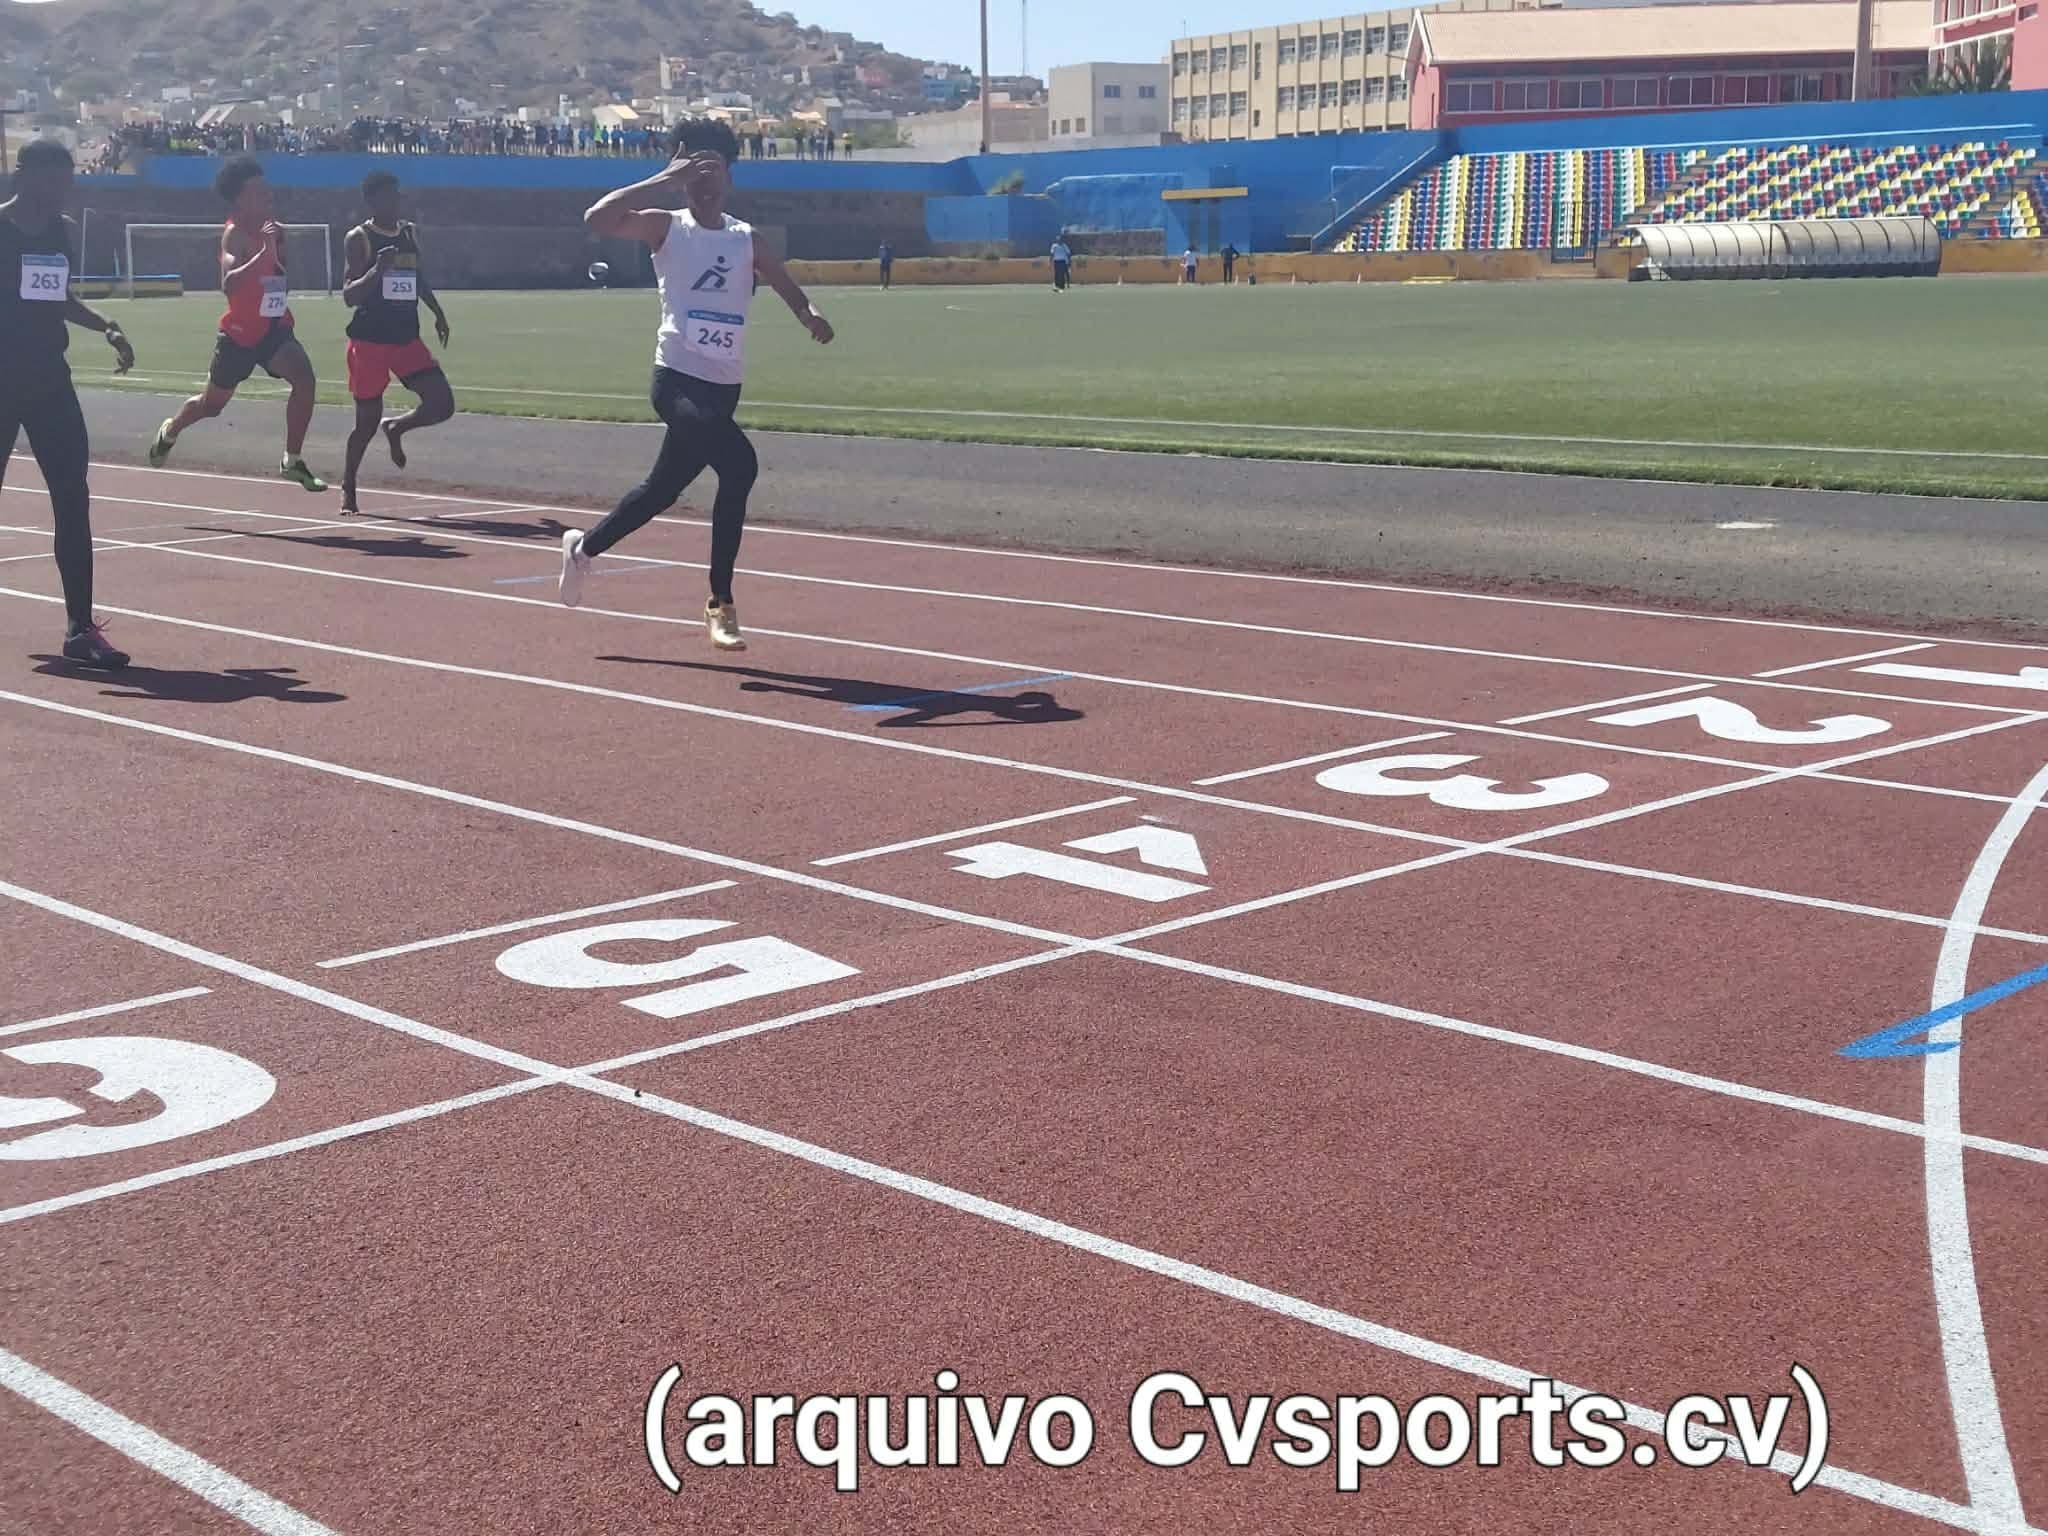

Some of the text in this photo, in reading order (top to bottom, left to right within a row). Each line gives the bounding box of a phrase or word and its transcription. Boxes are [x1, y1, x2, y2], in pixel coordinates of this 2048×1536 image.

[31, 272, 61, 290] 263
[697, 327, 735, 349] 245
[1587, 696, 1893, 745] 2
[1315, 753, 1610, 811] 3
[943, 825, 1212, 903] 4
[494, 918, 863, 1019] 5
